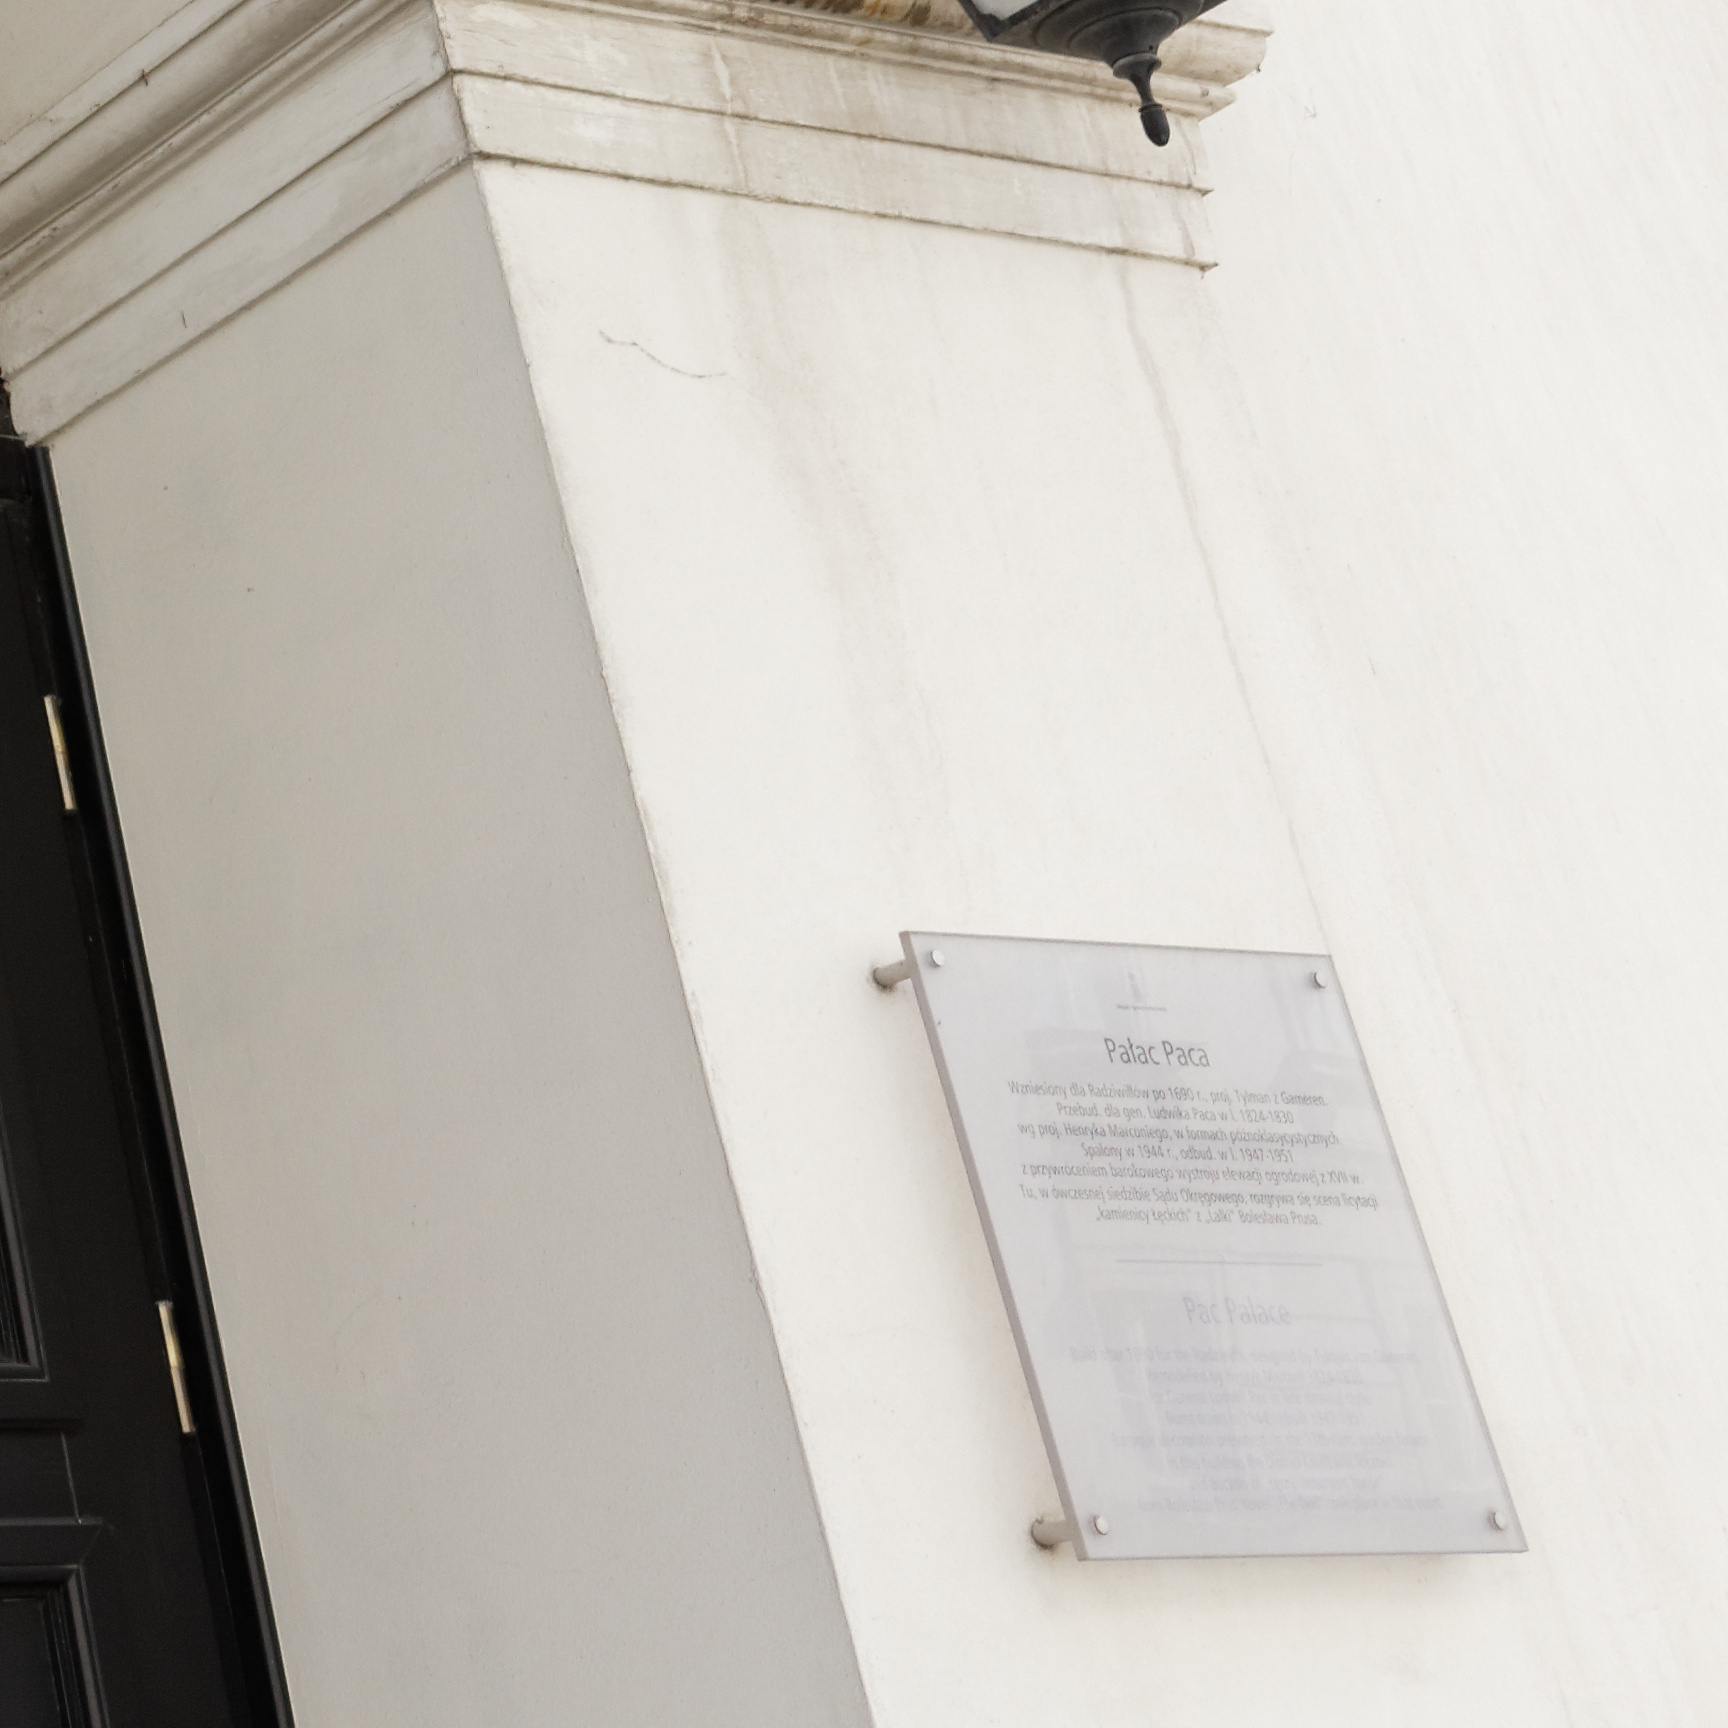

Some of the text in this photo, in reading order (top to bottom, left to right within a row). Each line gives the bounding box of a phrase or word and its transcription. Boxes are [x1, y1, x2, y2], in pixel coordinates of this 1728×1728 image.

[1103, 1036, 1211, 1068] Pałac Paca
[1008, 1081, 1066, 1099] Wzniesiony
[1070, 1082, 1085, 1097] dla
[1152, 1089, 1166, 1102] po
[1168, 1087, 1194, 1101] 1690
[1234, 1089, 1270, 1106] Tylman
[1274, 1093, 1279, 1104] z
[1057, 1102, 1102, 1117] Przebud.
[1104, 1104, 1120, 1118] dla
[1123, 1107, 1146, 1121] gen.
[1148, 1106, 1189, 1120] Ludwika
[1192, 1107, 1216, 1121] Paca
[1218, 1111, 1228, 1121] w
[1017, 1122, 1035, 1139] wg
[1063, 1122, 1106, 1139] Henryka
[1108, 1124, 1172, 1142] Marconiego,
[1174, 1128, 1184, 1139] w
[1187, 1126, 1227, 1141] formach
[1081, 1142, 1122, 1161] Spalony
[1125, 1147, 1134, 1157] w
[1138, 1145, 1163, 1159] 1944
[1218, 1150, 1228, 1160] w
[1240, 1147, 1294, 1162] 1947-1951
[1021, 1164, 1027, 1176] z
[1029, 1162, 1108, 1179] przywróceniem
[1109, 1163, 1173, 1182] barokowego
[1177, 1168, 1219, 1183] wystroju
[1222, 1167, 1262, 1185] elewacji
[1265, 1170, 1319, 1186] ogrodowej
[1321, 1173, 1326, 1183] z
[1327, 1170, 1348, 1184] XVII
[1038, 1188, 1049, 1199] w
[1052, 1185, 1106, 1204] ówczesnej
[1107, 1186, 1150, 1202] siedzibie
[1153, 1187, 1177, 1204] Sądu
[1249, 1193, 1294, 1208] rozgrywa
[1297, 1192, 1312, 1208] się
[1313, 1195, 1341, 1207] scena
[1341, 1192, 1378, 1211] licytacji
[1195, 1212, 1201, 1222] z
[1238, 1210, 1288, 1224] Bolesława
[1290, 1212, 1322, 1225] Prusa.
[1182, 1296, 1292, 1326] Pac Palace
